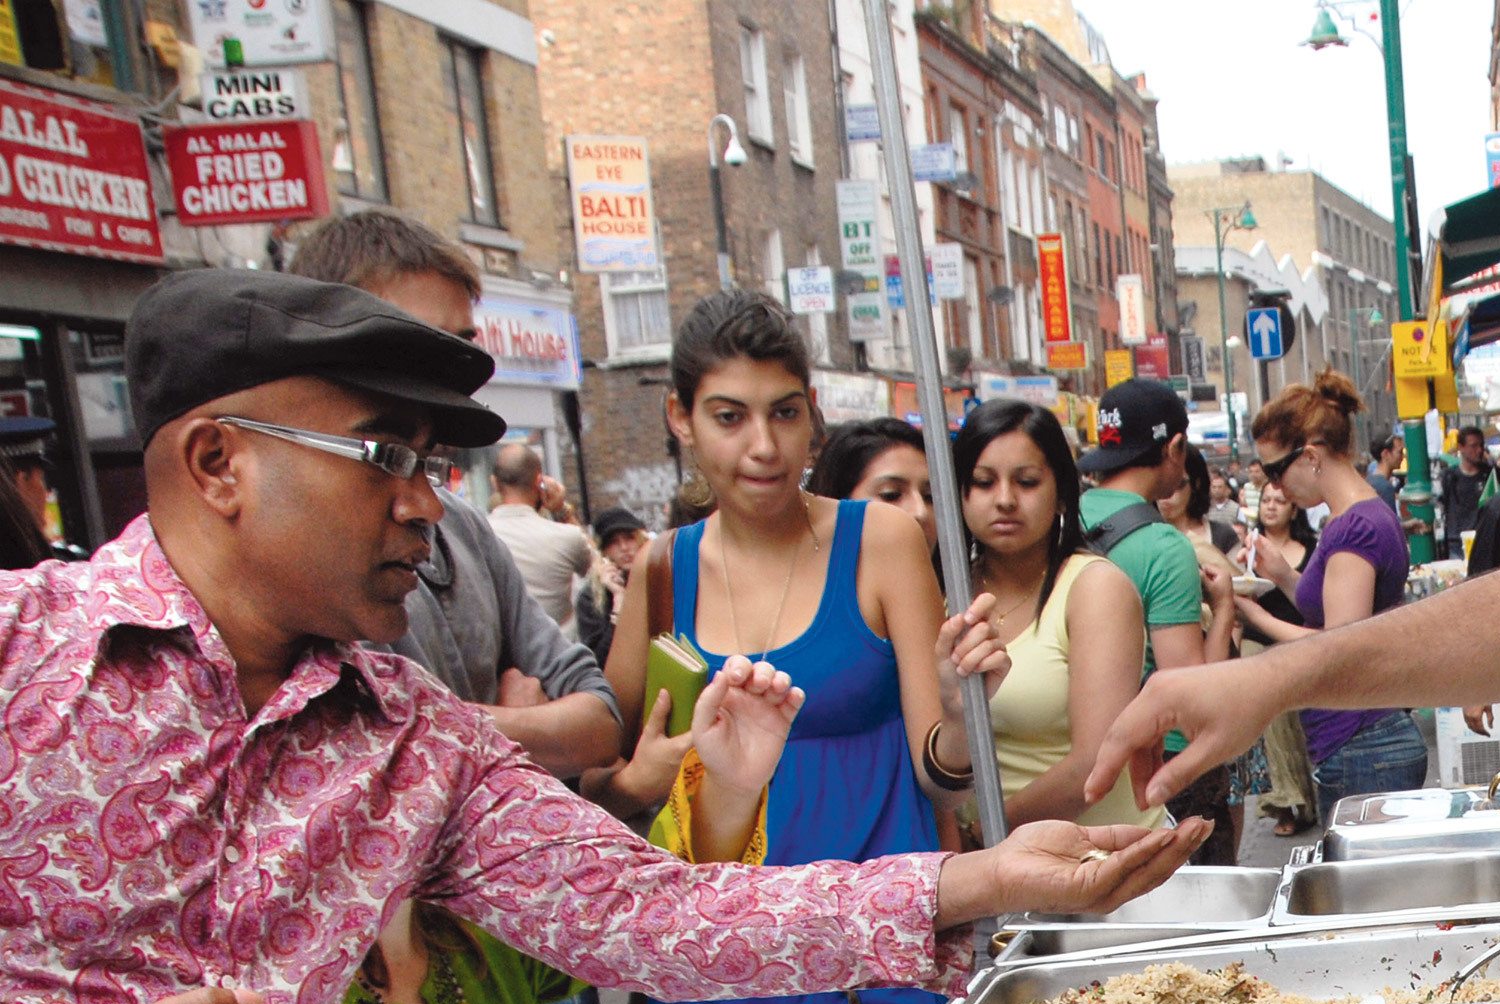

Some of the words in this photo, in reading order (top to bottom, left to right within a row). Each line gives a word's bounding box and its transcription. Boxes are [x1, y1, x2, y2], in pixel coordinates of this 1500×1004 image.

[215, 73, 282, 95] MINI
[208, 96, 295, 119] CABS
[186, 136, 213, 154] AL
[217, 131, 287, 151] HALAL
[573, 144, 643, 160] EASTERN
[196, 150, 285, 184] FRIED
[596, 165, 623, 180] EYE
[14, 153, 152, 222] CHICKEN
[182, 178, 308, 215] CHICKEN
[580, 195, 647, 218] BALTI
[582, 221, 647, 235] HOUSE
